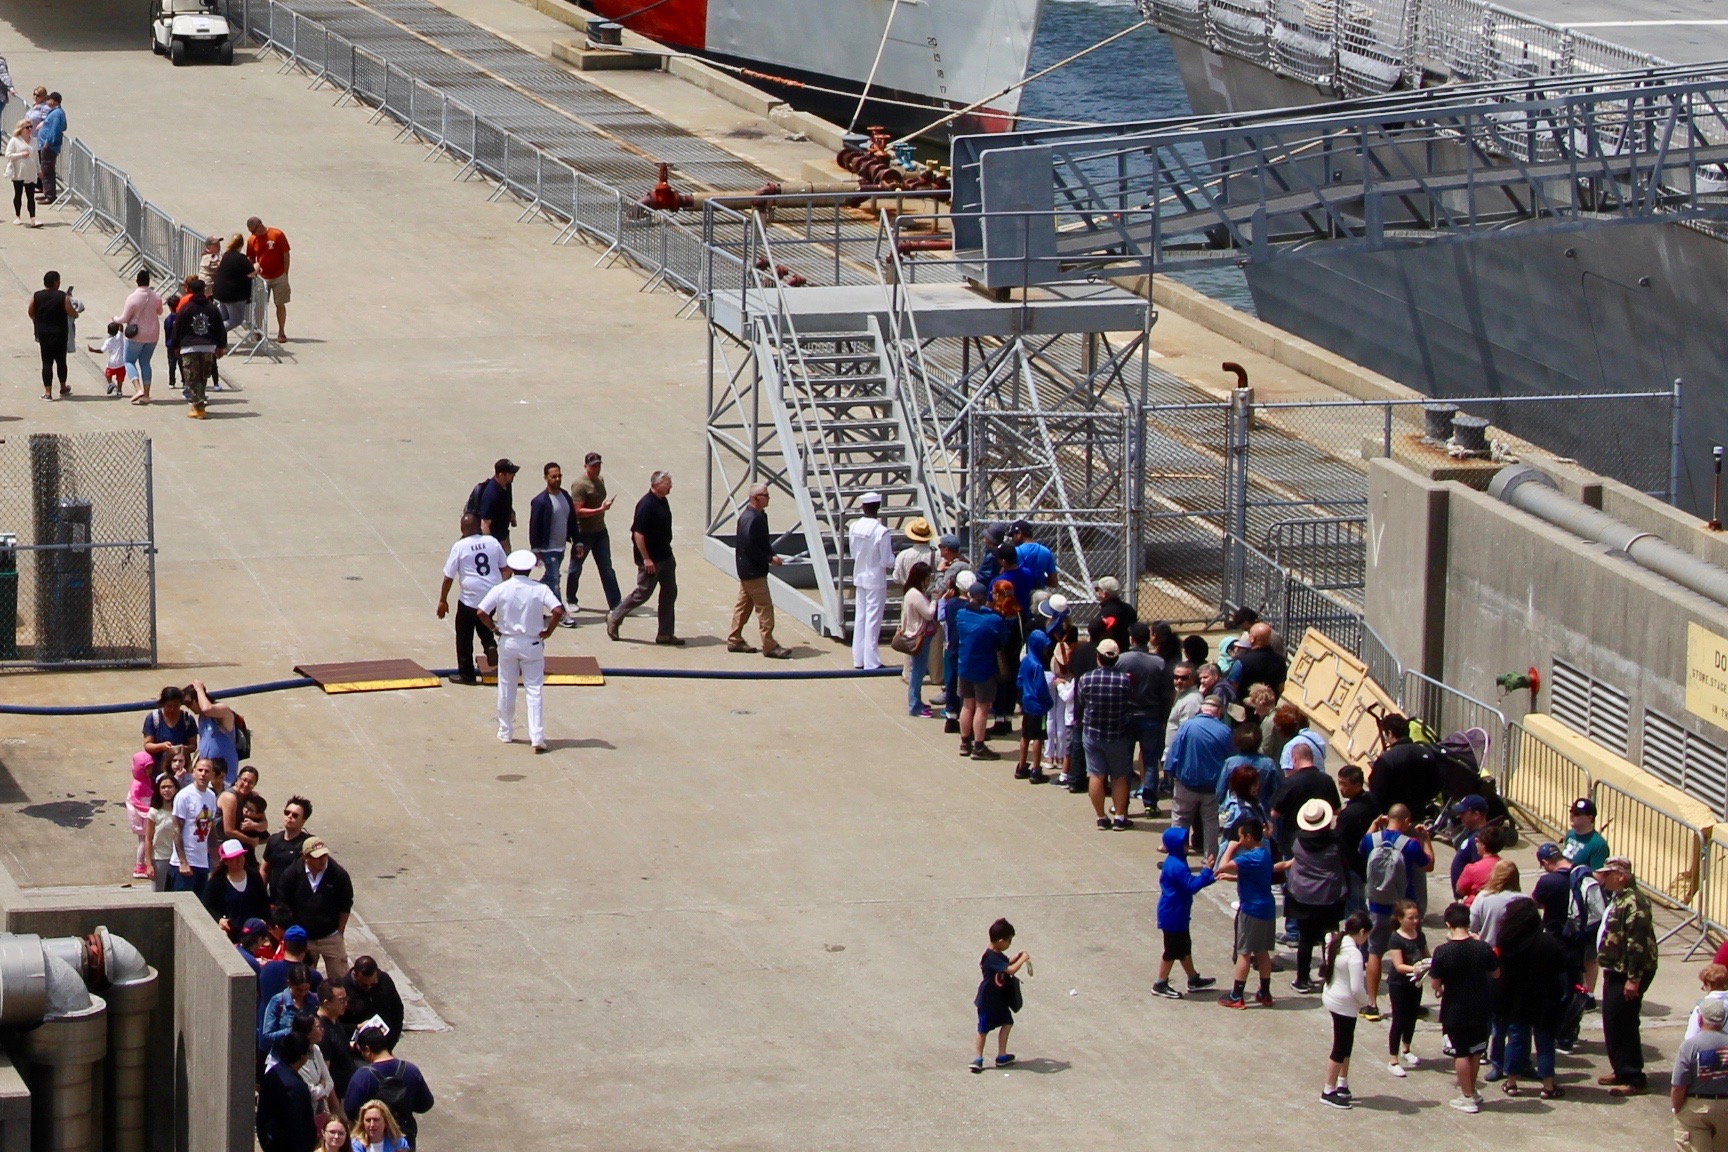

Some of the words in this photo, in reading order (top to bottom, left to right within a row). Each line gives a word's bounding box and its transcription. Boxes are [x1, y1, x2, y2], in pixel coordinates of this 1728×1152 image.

[927, 36, 938, 47] 20
[471, 543, 487, 552] KAKA
[474, 552, 491, 576] 8
[1714, 649, 1727, 672] DO
